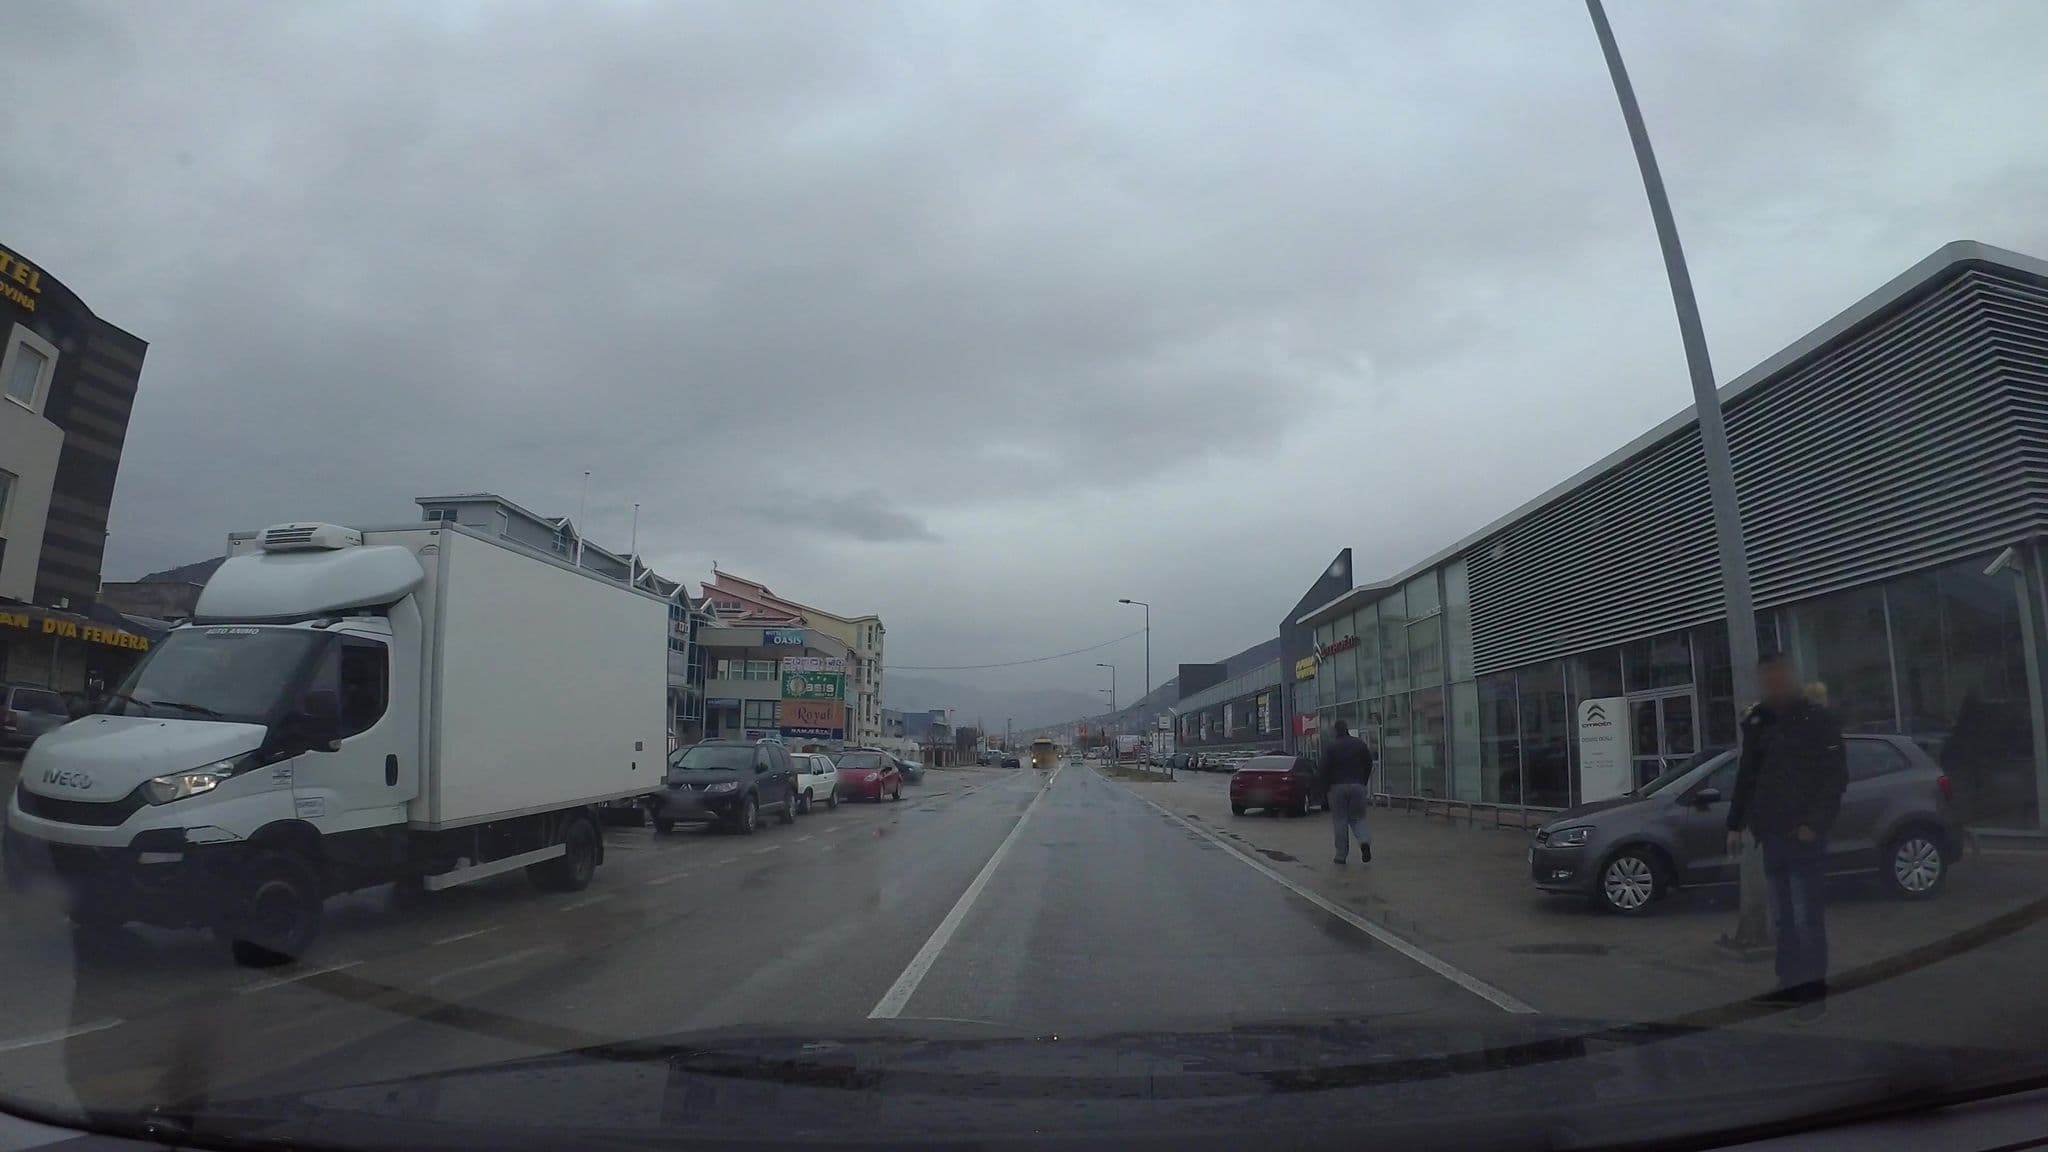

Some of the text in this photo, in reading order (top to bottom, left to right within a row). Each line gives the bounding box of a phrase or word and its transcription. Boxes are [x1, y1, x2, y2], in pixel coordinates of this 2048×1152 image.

[42, 618, 76, 638] DVA
[83, 627, 149, 651] FENJERA
[773, 636, 802, 645] OASIS
[42, 769, 93, 790] IVECO
